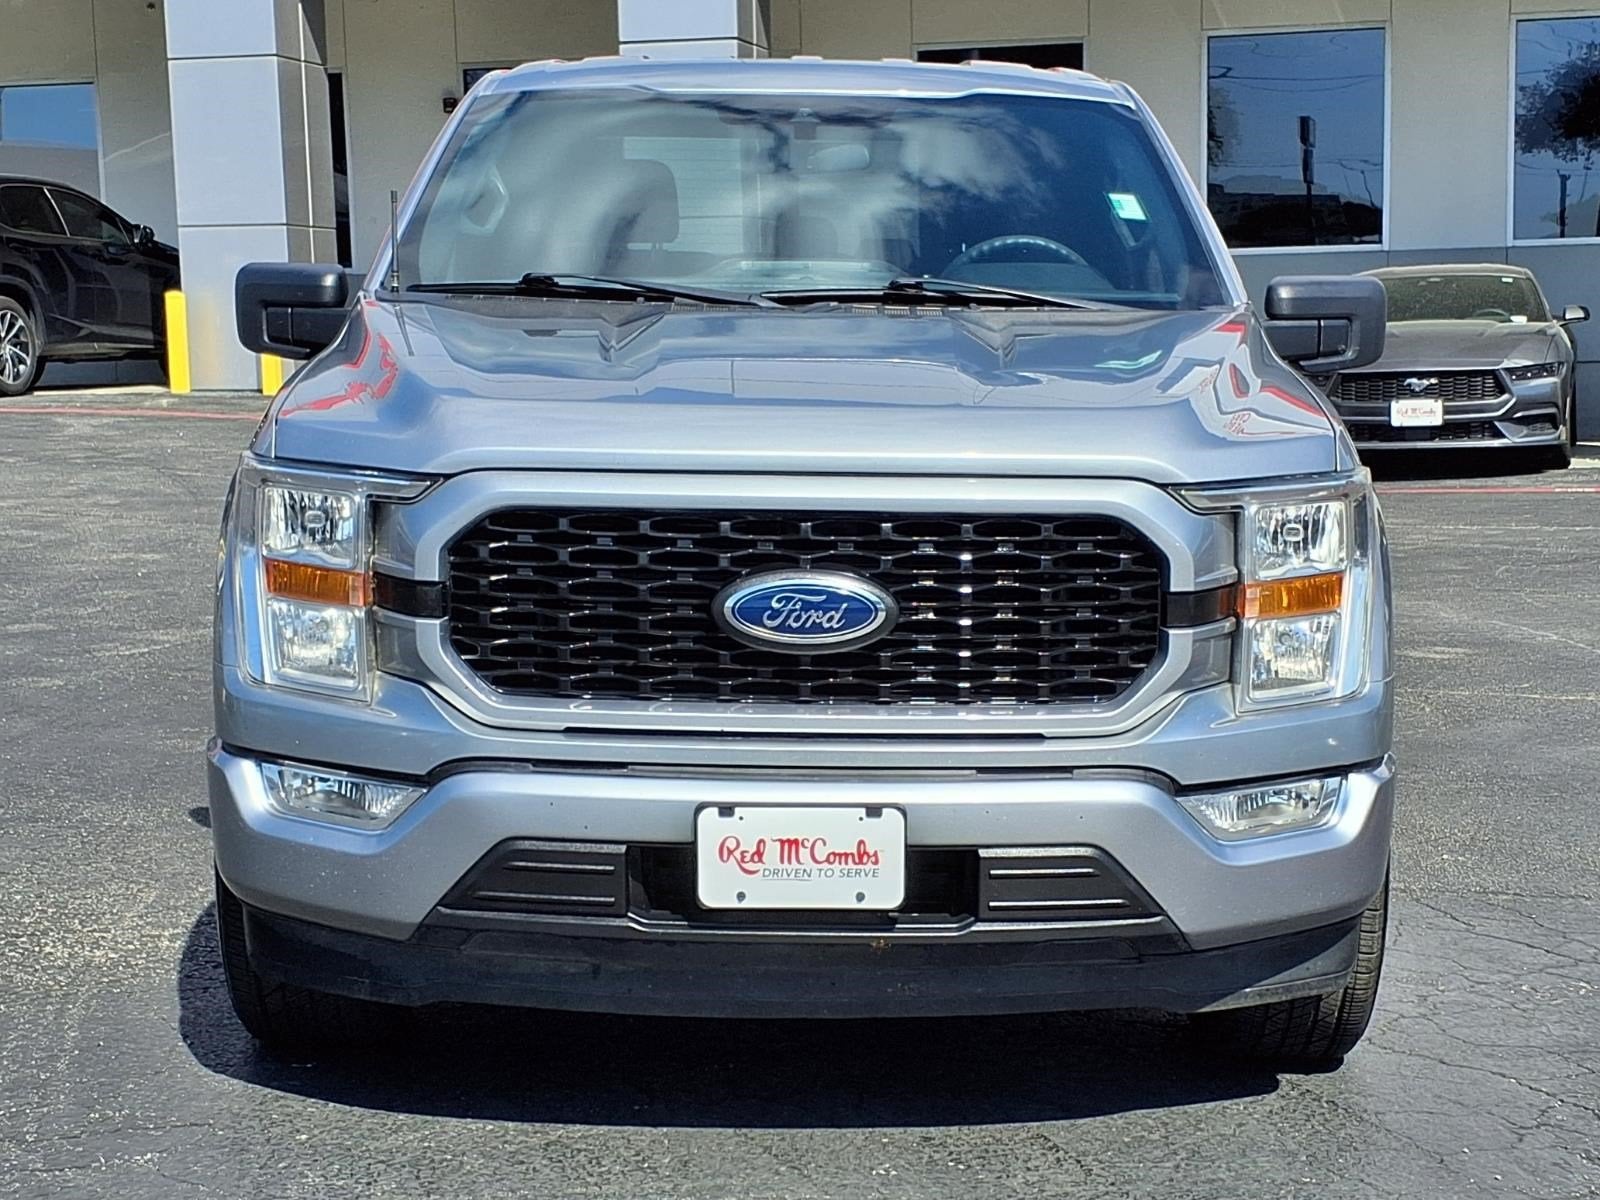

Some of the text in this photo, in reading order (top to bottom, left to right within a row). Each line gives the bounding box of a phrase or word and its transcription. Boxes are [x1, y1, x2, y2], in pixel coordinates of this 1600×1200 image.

[763, 593, 848, 629] Ford
[718, 836, 879, 875] Red McCombs
[762, 868, 880, 878] DRIVEN TO SERVE
